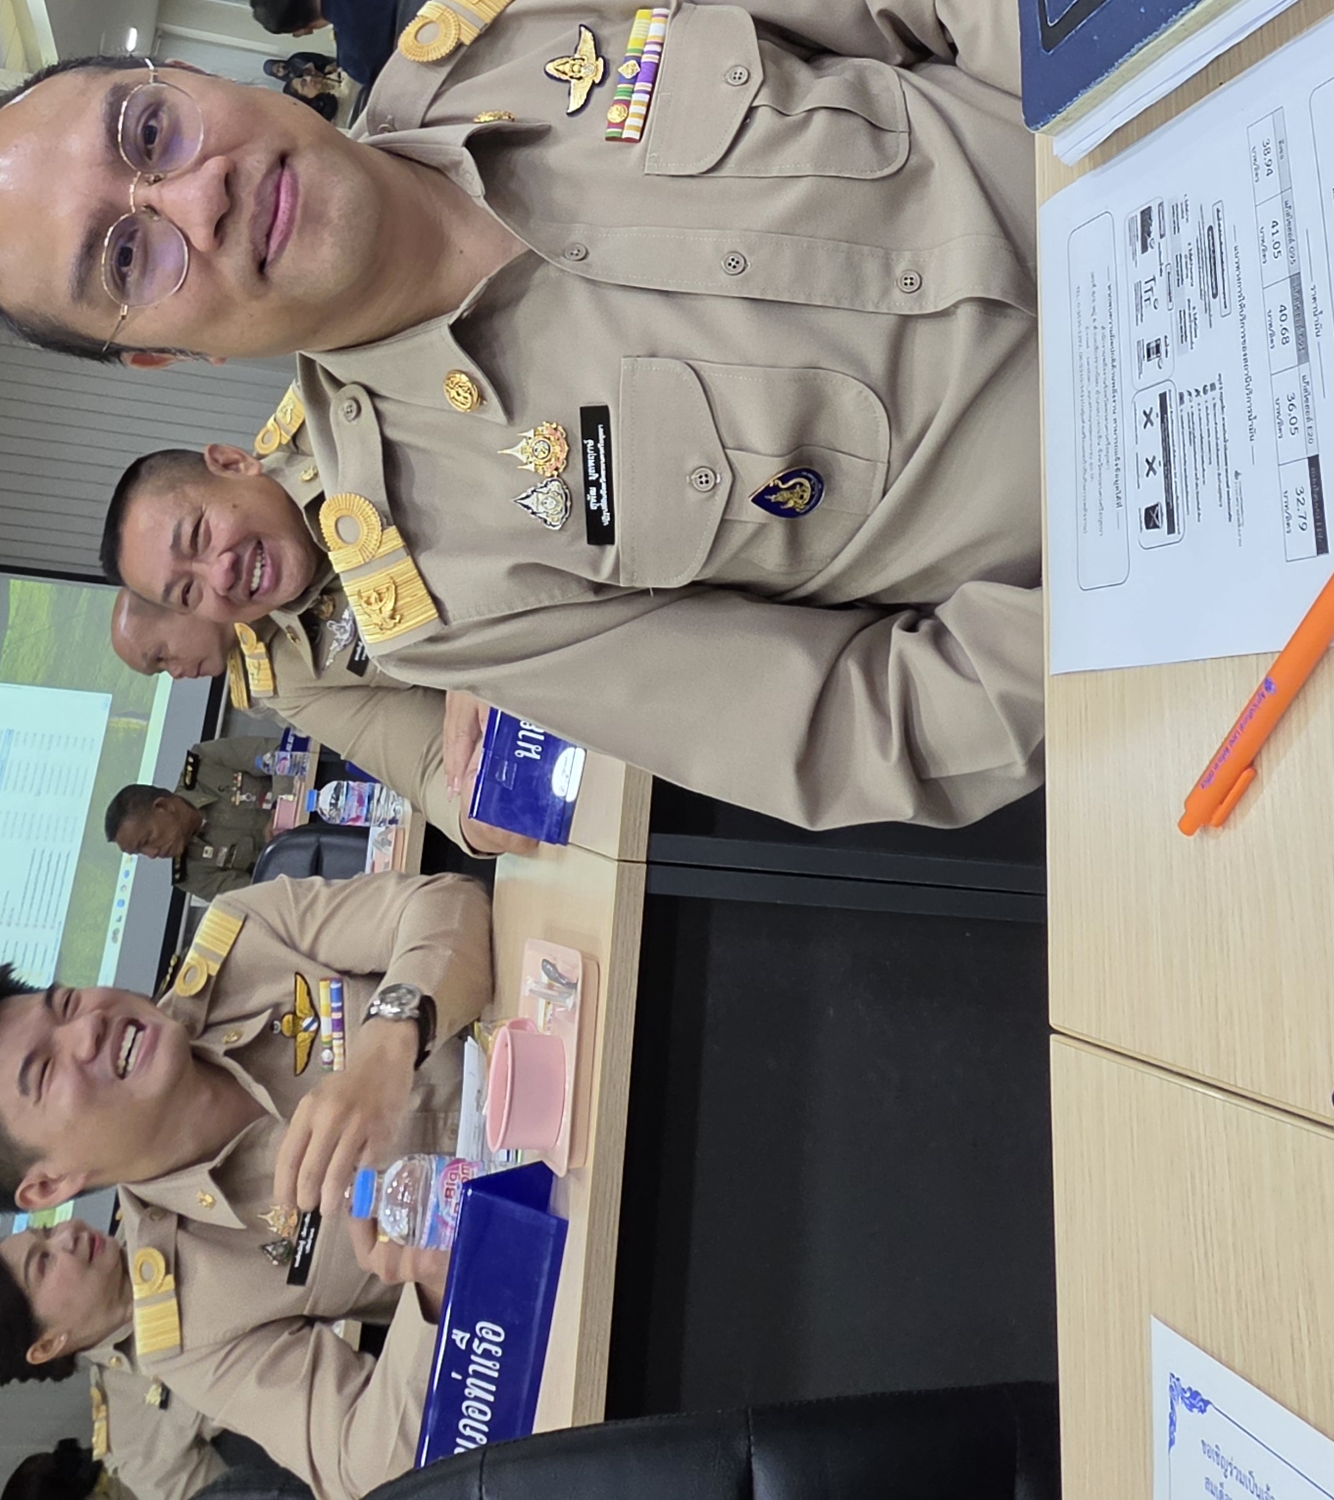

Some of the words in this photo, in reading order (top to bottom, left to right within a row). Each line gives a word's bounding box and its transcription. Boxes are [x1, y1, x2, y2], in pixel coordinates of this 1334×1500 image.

[1262, 138, 1274, 177] 38.94
[1270, 220, 1283, 260] 41.05
[1278, 304, 1291, 346] 40.68
[1286, 392, 1299, 436] 36.05
[1295, 486, 1308, 532] 32.79
[444, 1172, 461, 1198] Big
